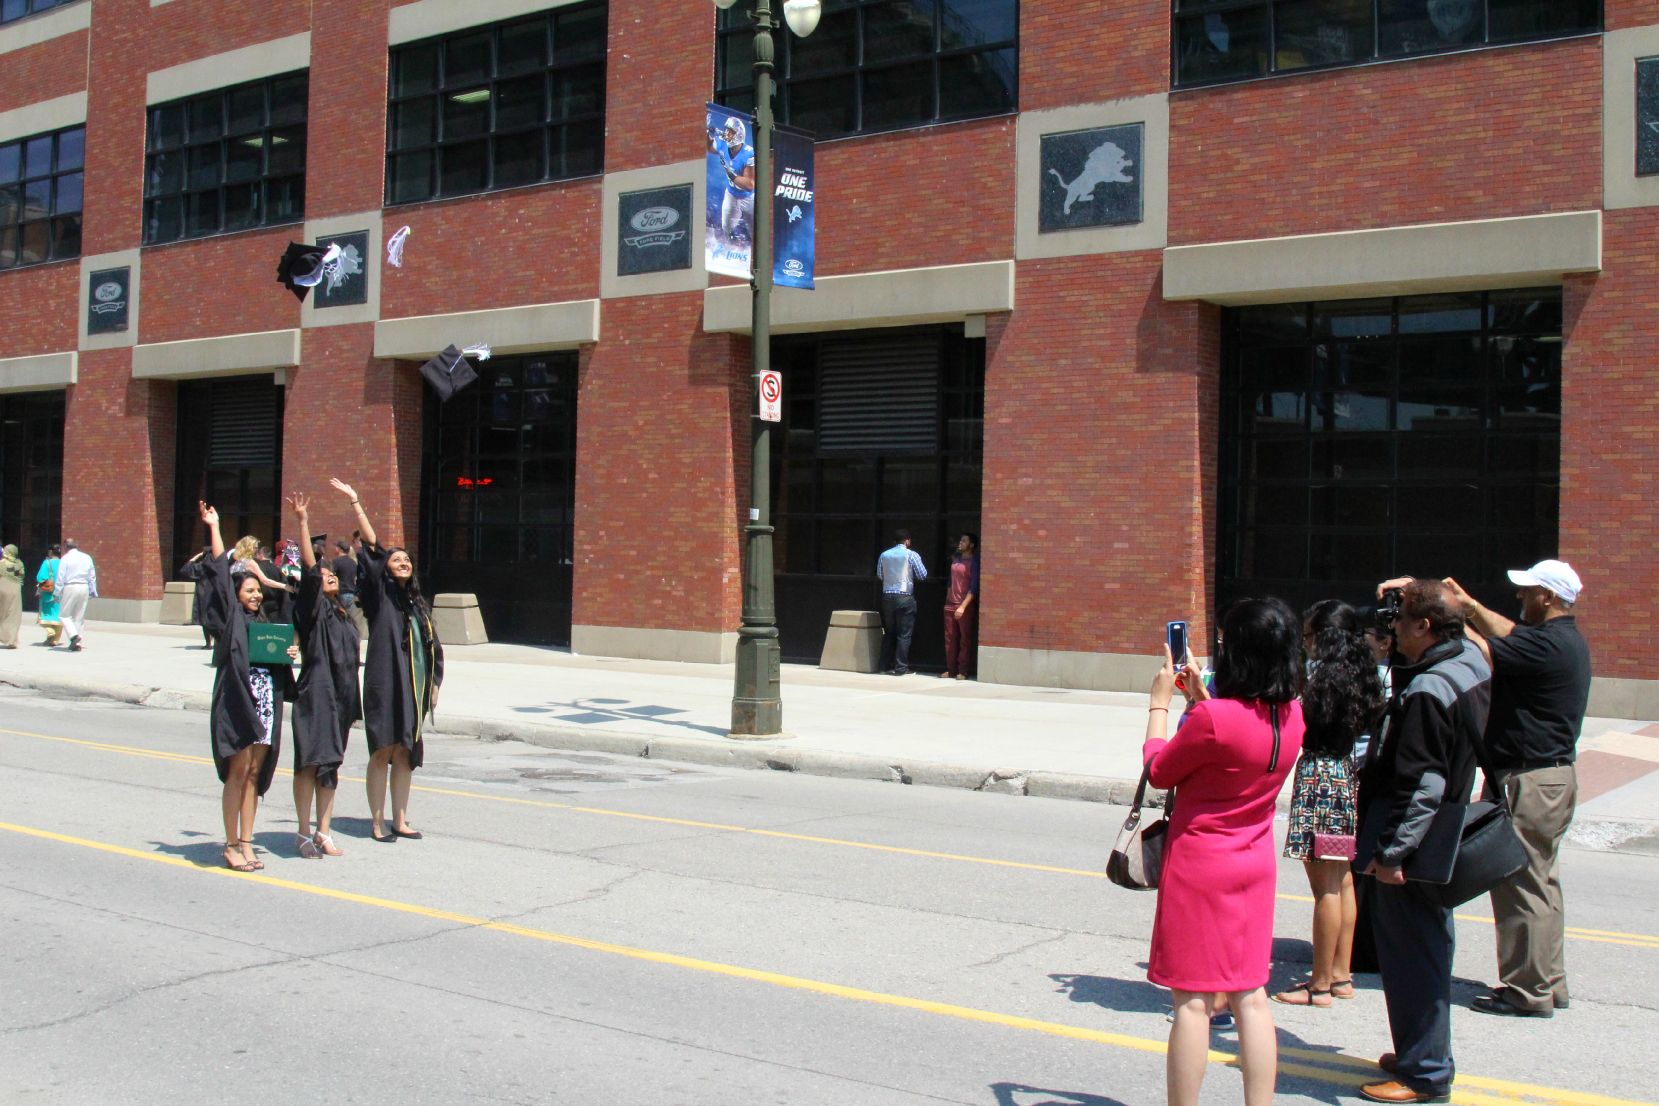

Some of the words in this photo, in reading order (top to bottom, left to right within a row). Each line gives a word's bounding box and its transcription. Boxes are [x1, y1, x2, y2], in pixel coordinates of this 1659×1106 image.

[781, 173, 807, 188] ONE
[775, 185, 814, 203] PRIDE
[641, 210, 669, 228] Ford
